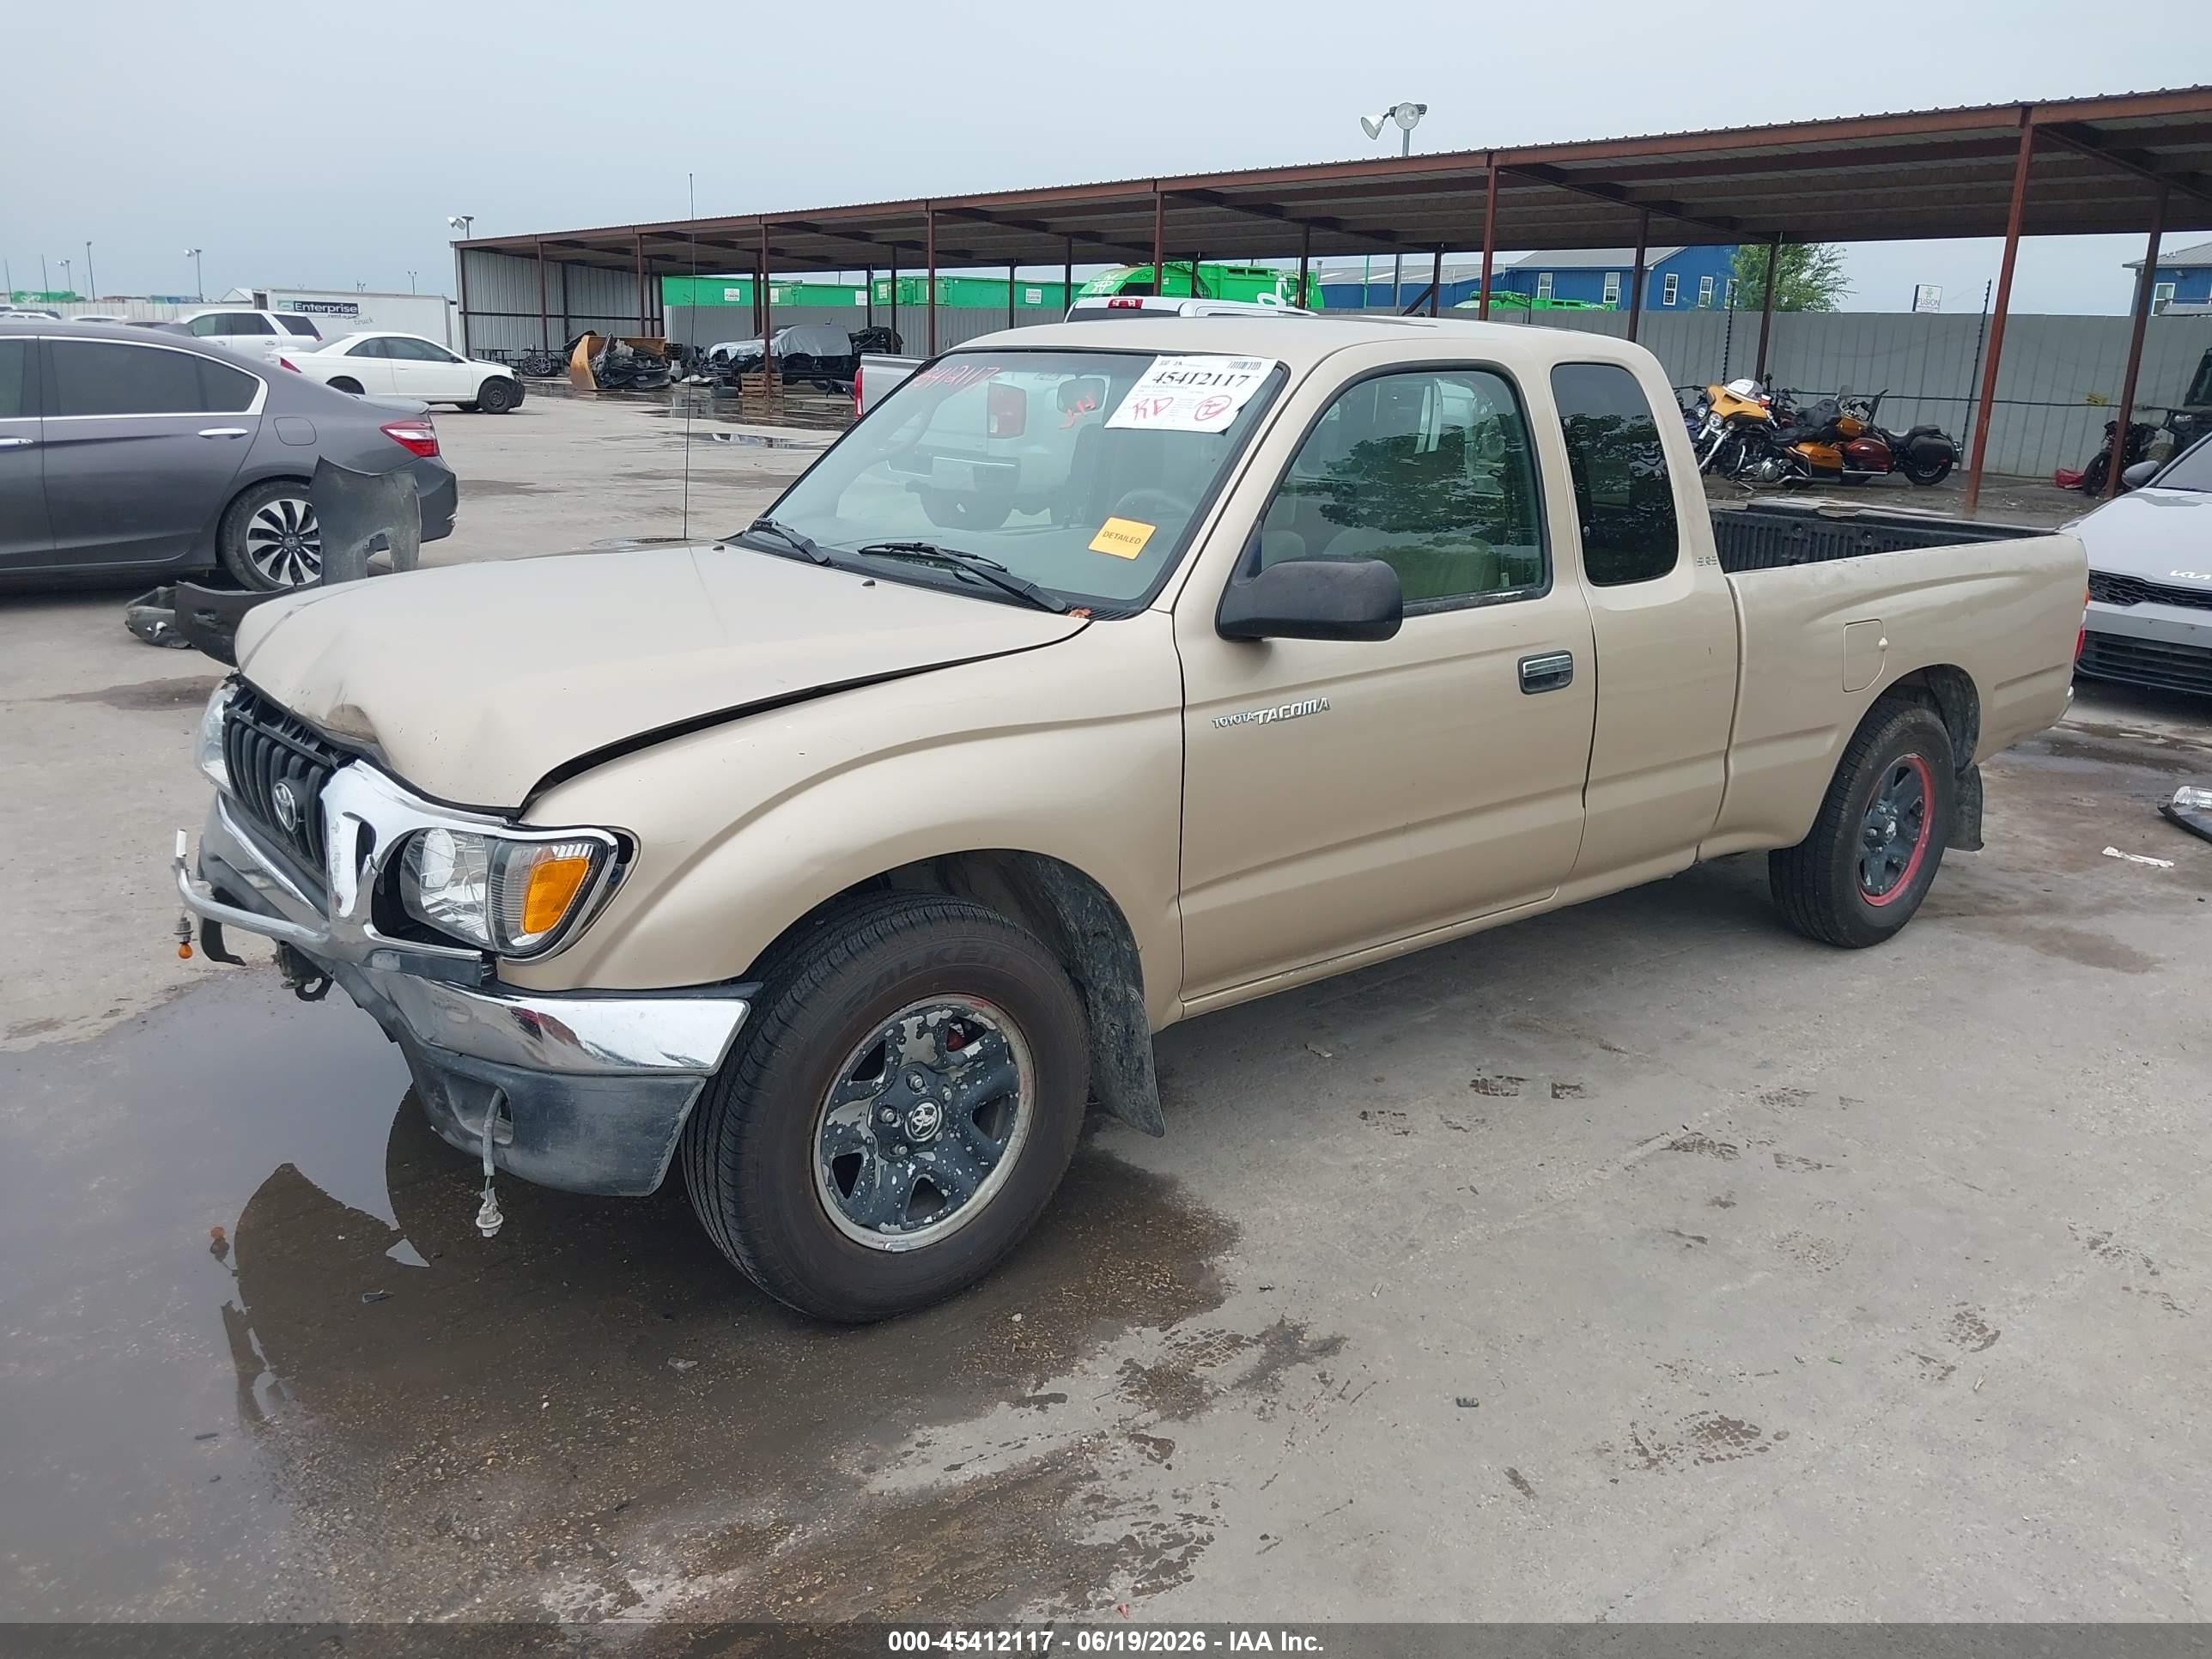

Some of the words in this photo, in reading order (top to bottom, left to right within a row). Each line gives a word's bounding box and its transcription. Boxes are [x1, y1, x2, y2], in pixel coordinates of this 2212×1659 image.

[295, 302, 357, 313] Enterprise
[1152, 371, 1251, 388] 45412117
[1103, 531, 1141, 544] DETAILED
[1212, 713, 1255, 728] TOYOTA
[1254, 697, 1330, 725] TACOMA
